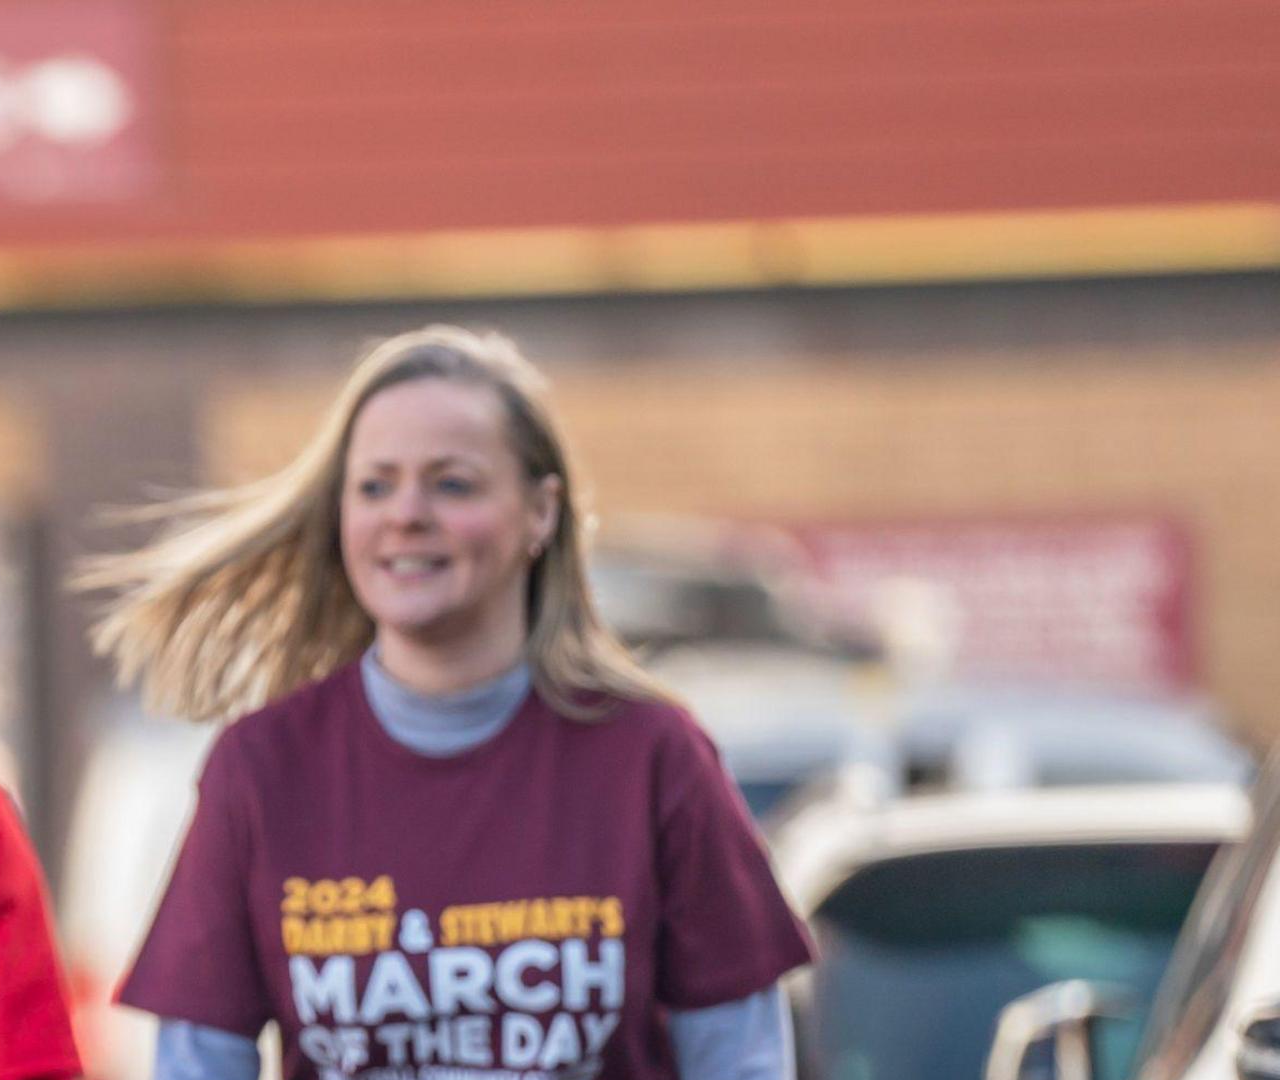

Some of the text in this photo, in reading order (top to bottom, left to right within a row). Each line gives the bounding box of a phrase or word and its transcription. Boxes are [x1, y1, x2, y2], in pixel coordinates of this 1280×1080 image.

[397, 908, 434, 953] &
[440, 895, 625, 947] STEWART'S
[288, 937, 626, 1026] MARCH
[374, 1010, 494, 1066] THE
[501, 1008, 621, 1069] DAY
